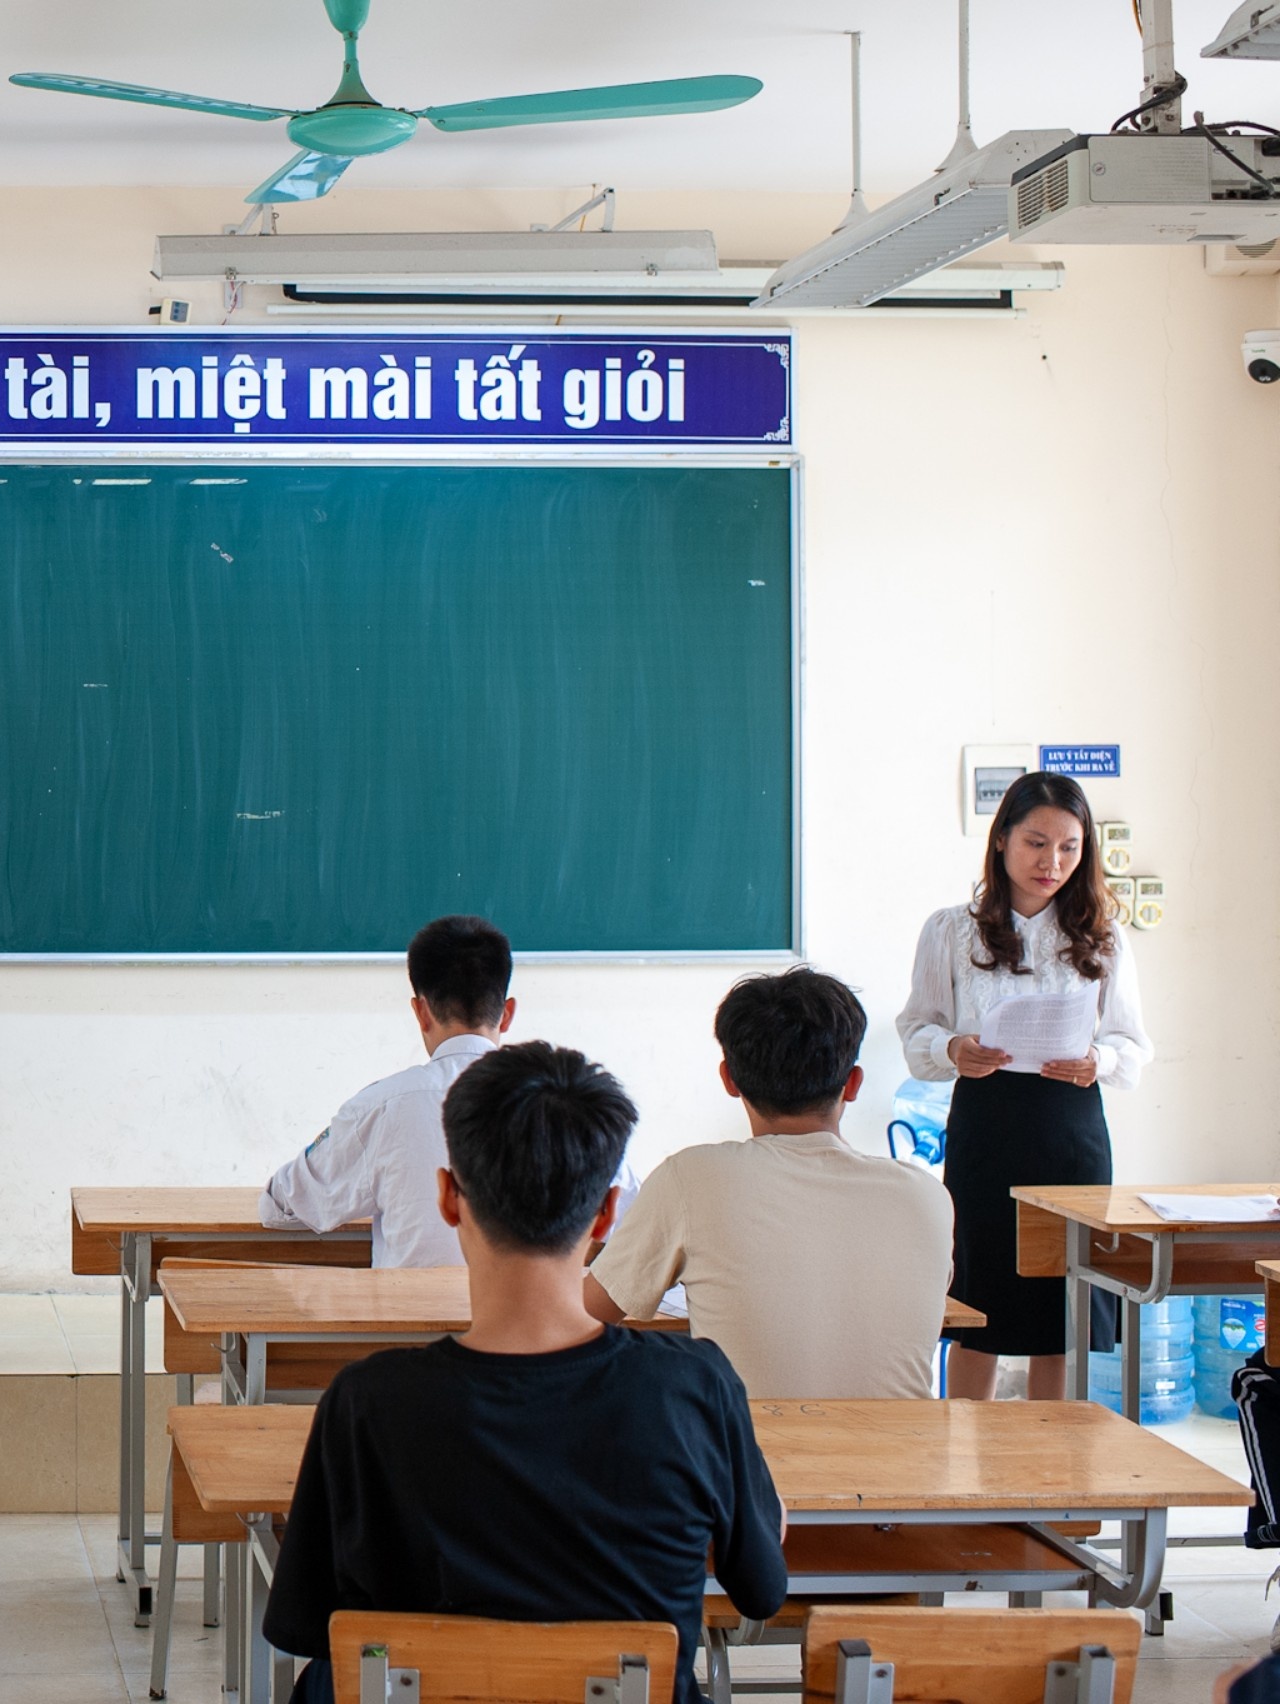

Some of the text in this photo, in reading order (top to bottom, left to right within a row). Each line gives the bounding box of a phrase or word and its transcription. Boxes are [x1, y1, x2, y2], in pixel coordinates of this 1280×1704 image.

[4, 353, 111, 427] tài,
[136, 354, 287, 433] miệt
[308, 354, 432, 421] mài
[454, 345, 542, 422] tất
[562, 349, 685, 429] giỏi
